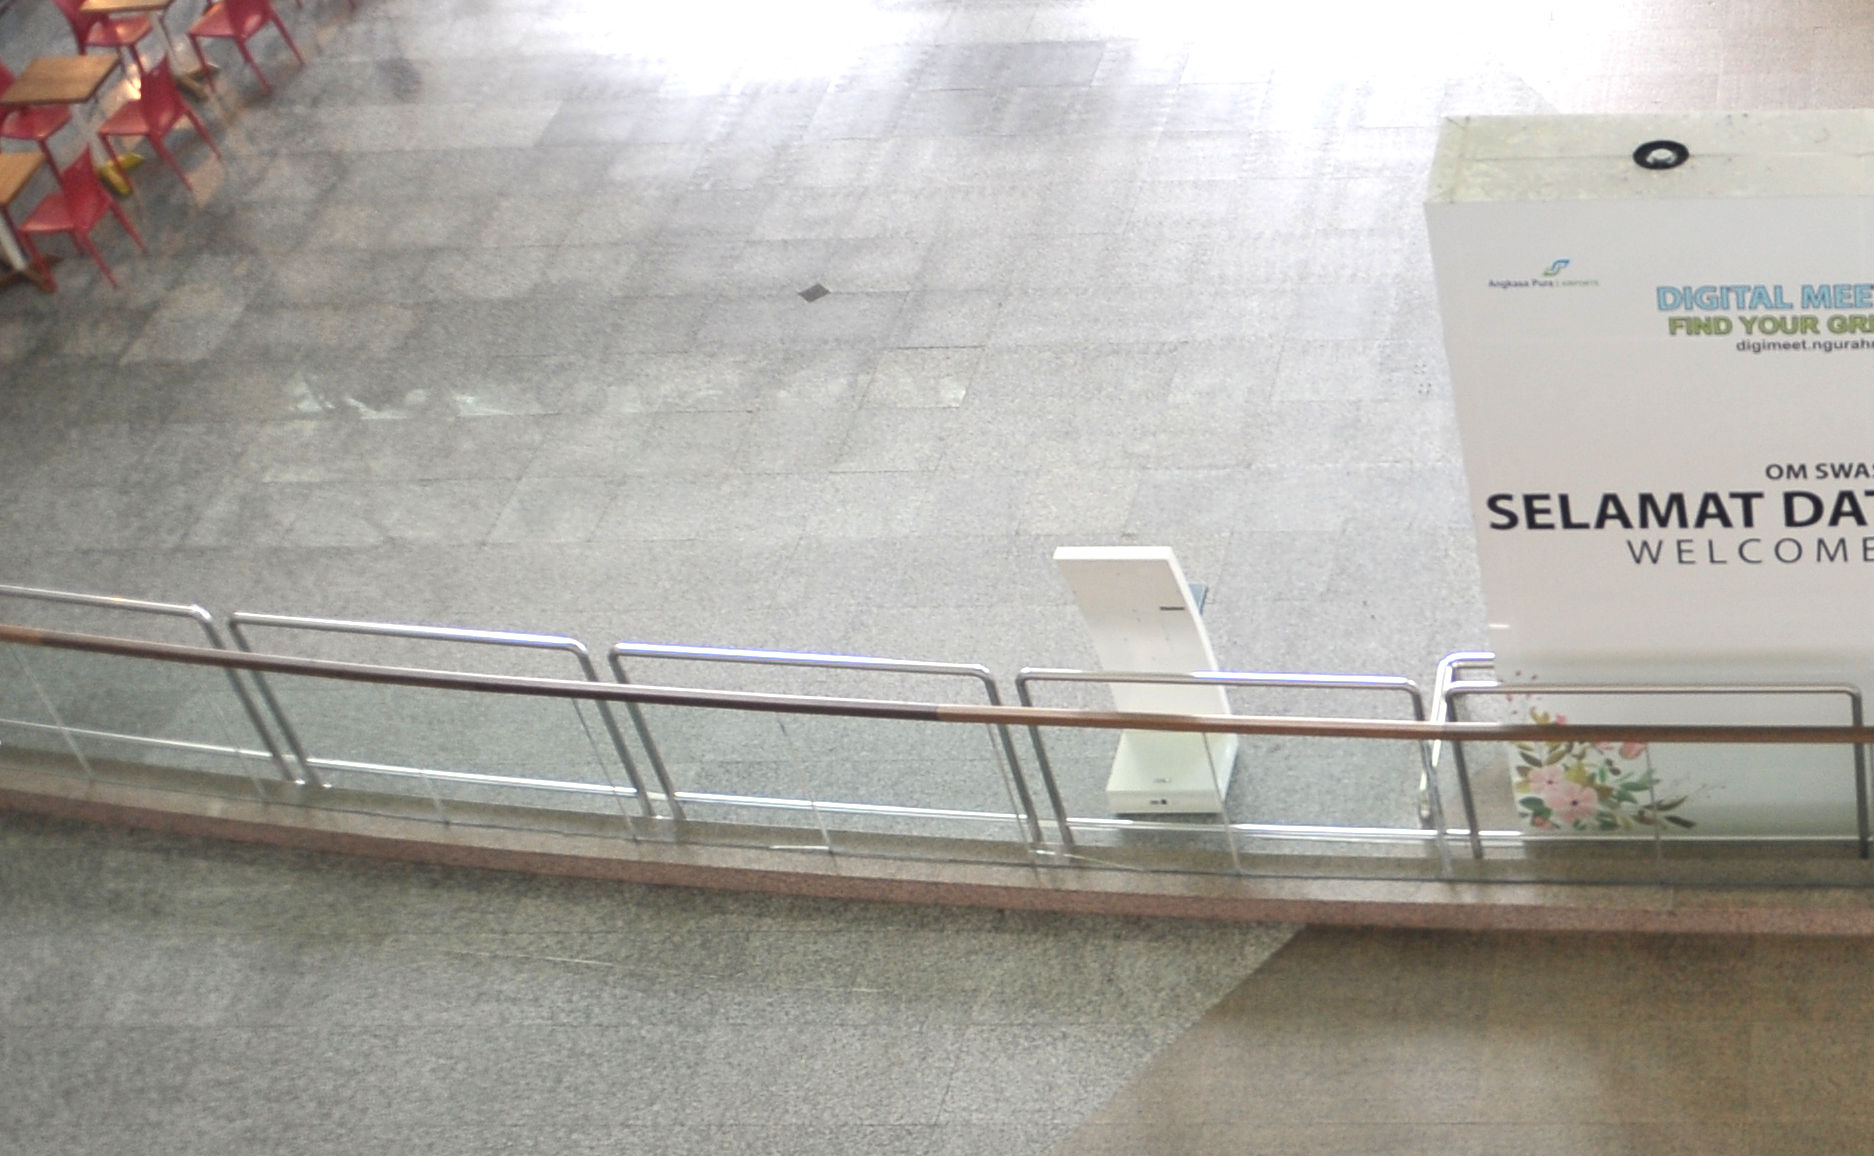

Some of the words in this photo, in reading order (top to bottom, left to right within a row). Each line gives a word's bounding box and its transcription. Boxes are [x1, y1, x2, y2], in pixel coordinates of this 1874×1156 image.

[1488, 279, 1529, 289] Angkasa
[1656, 284, 1793, 310] DIGITAL
[1668, 316, 1733, 336] FIND
[1738, 315, 1820, 335] YOUR
[1765, 463, 1808, 480] OM
[1487, 492, 1764, 530] SELAMAT
